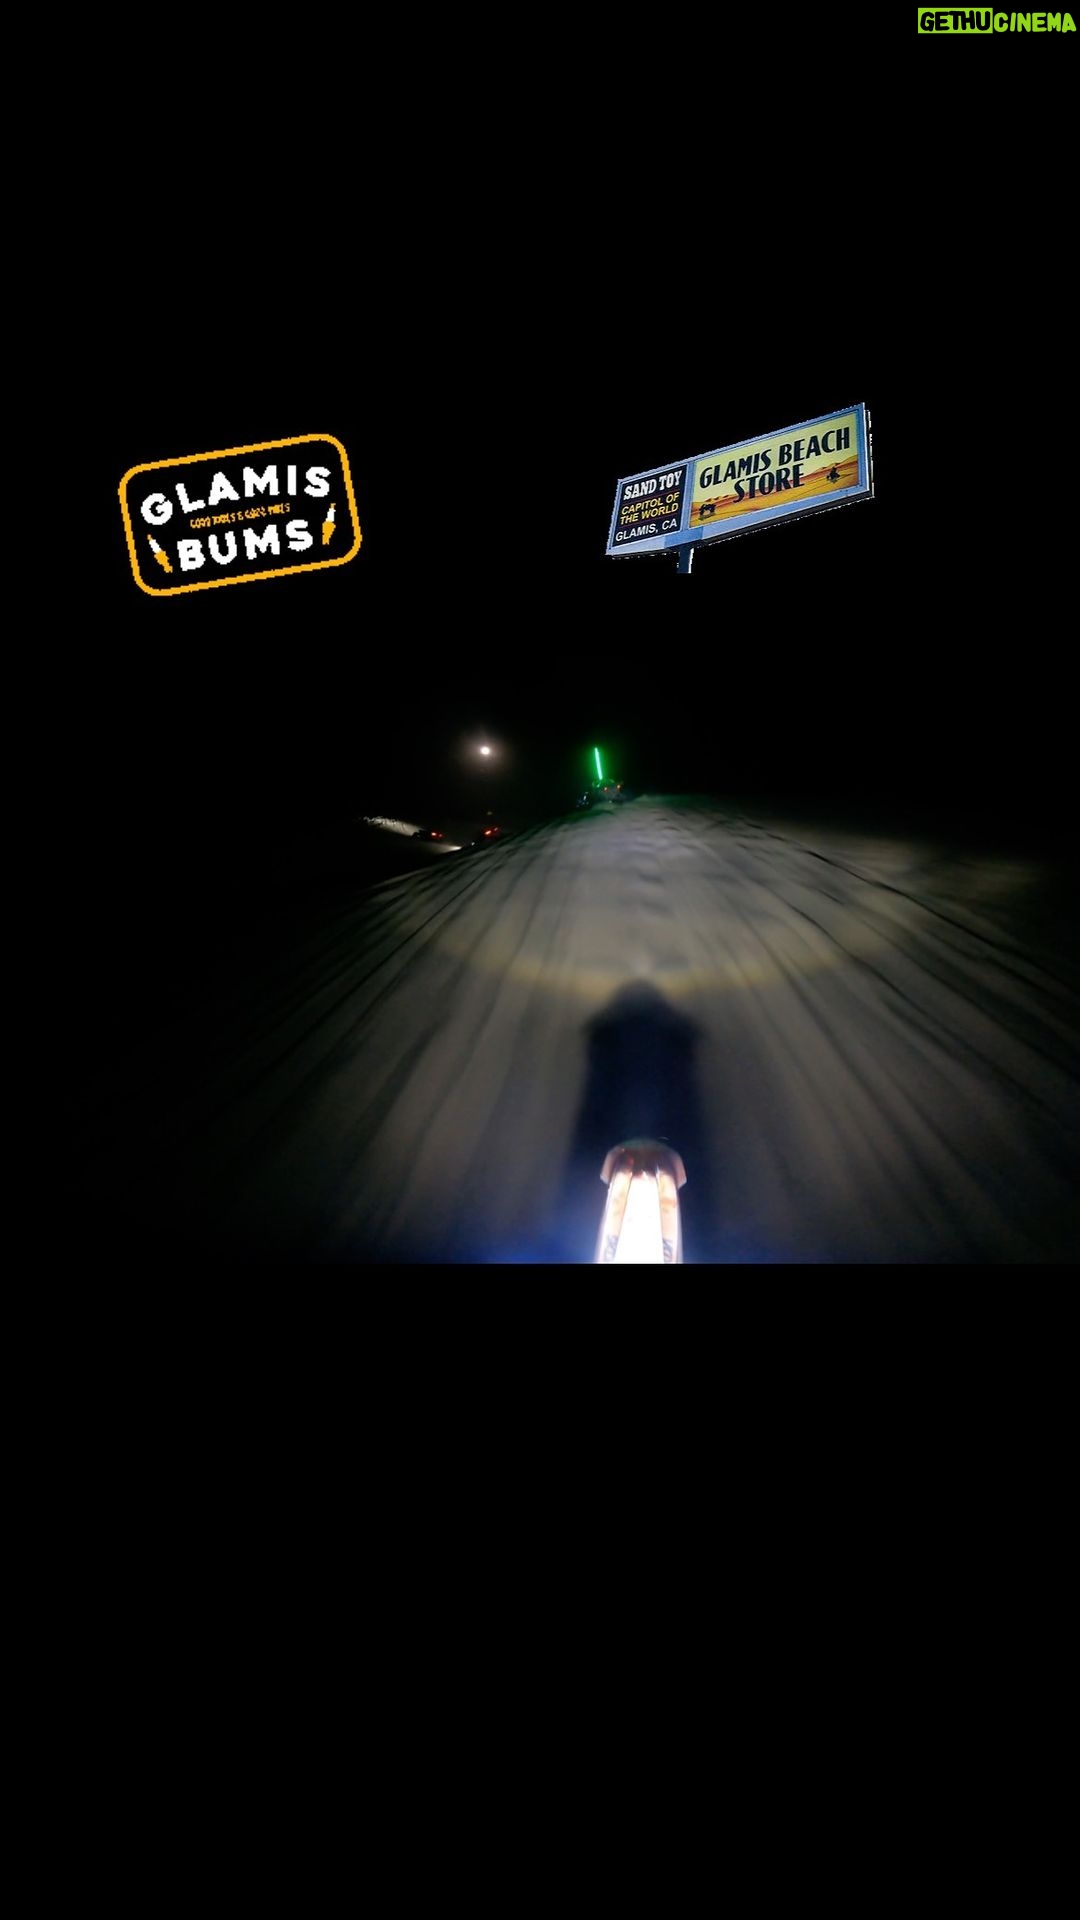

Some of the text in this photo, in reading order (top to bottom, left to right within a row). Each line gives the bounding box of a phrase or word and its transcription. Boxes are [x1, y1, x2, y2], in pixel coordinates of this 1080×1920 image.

[700, 427, 851, 489] GLAMIS BEACH
[623, 470, 682, 501] SAND TOY
[733, 463, 805, 503] STORE
[620, 503, 679, 525] THE WORLD
[621, 492, 680, 516] CAPITOL OF
[615, 518, 678, 542] GLAMIS, CA
